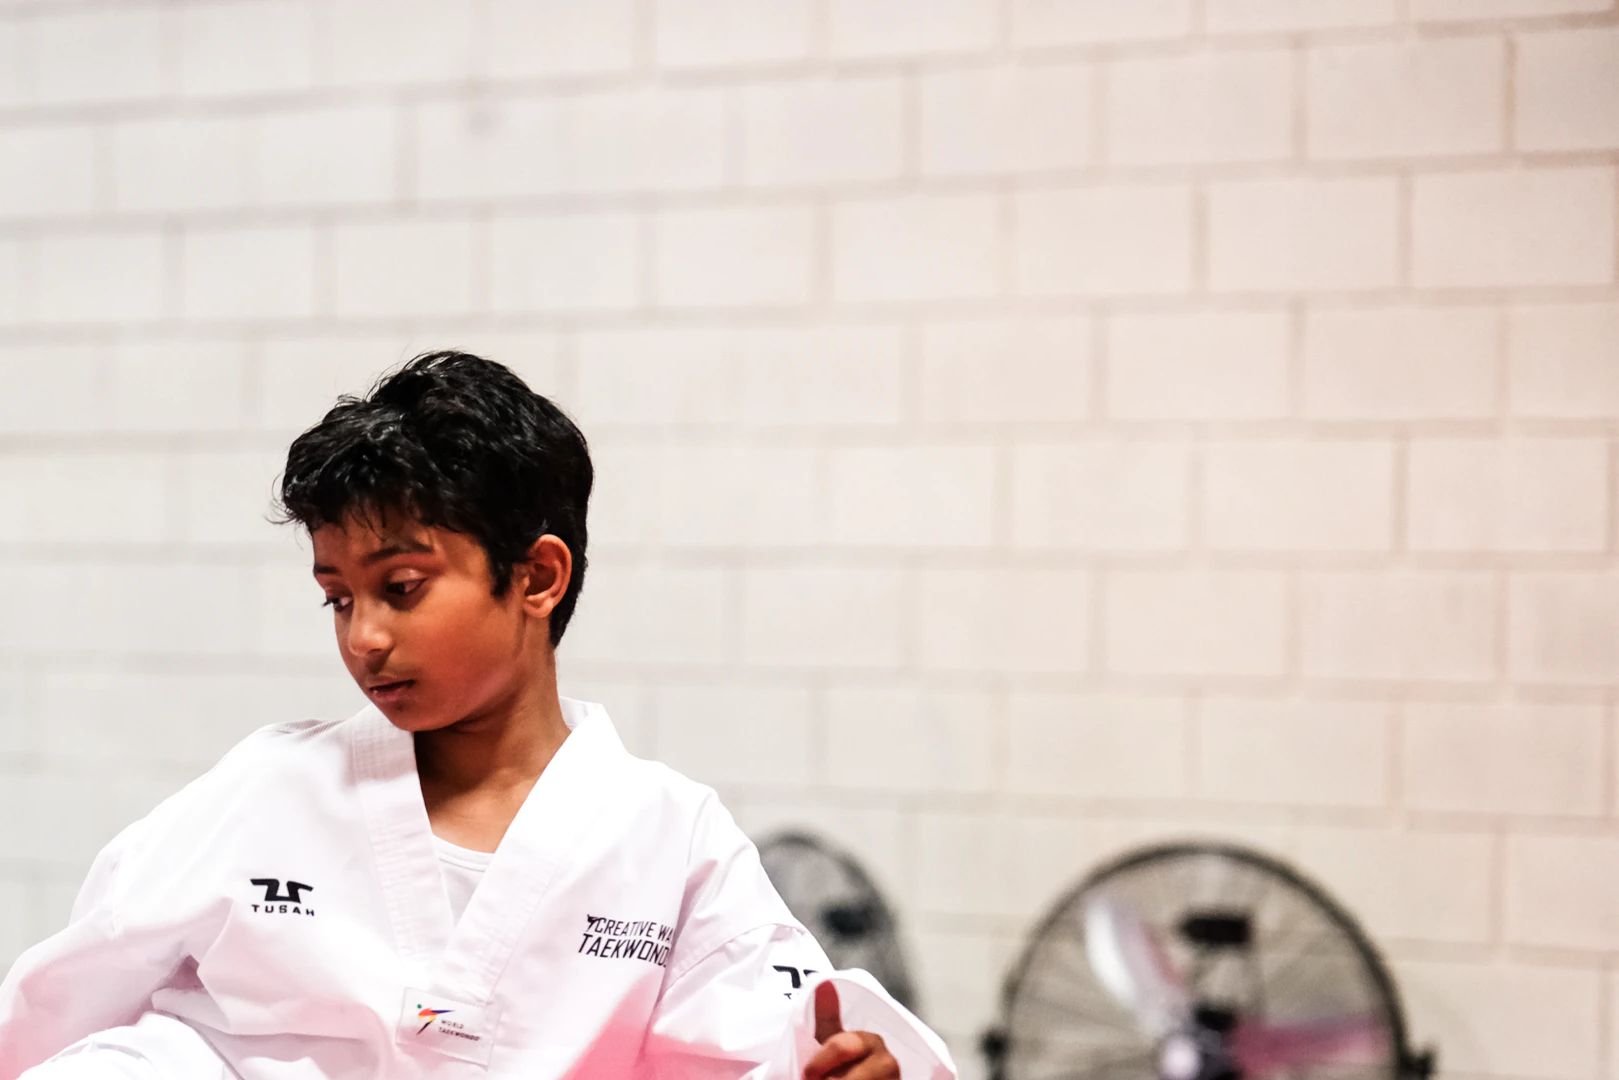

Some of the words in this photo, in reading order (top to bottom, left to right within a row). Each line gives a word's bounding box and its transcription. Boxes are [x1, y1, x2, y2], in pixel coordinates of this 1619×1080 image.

[251, 904, 315, 917] TUSAH
[594, 917, 657, 938] CREATIVE
[658, 924, 674, 942] WA
[578, 933, 670, 968] TAEKWOND
